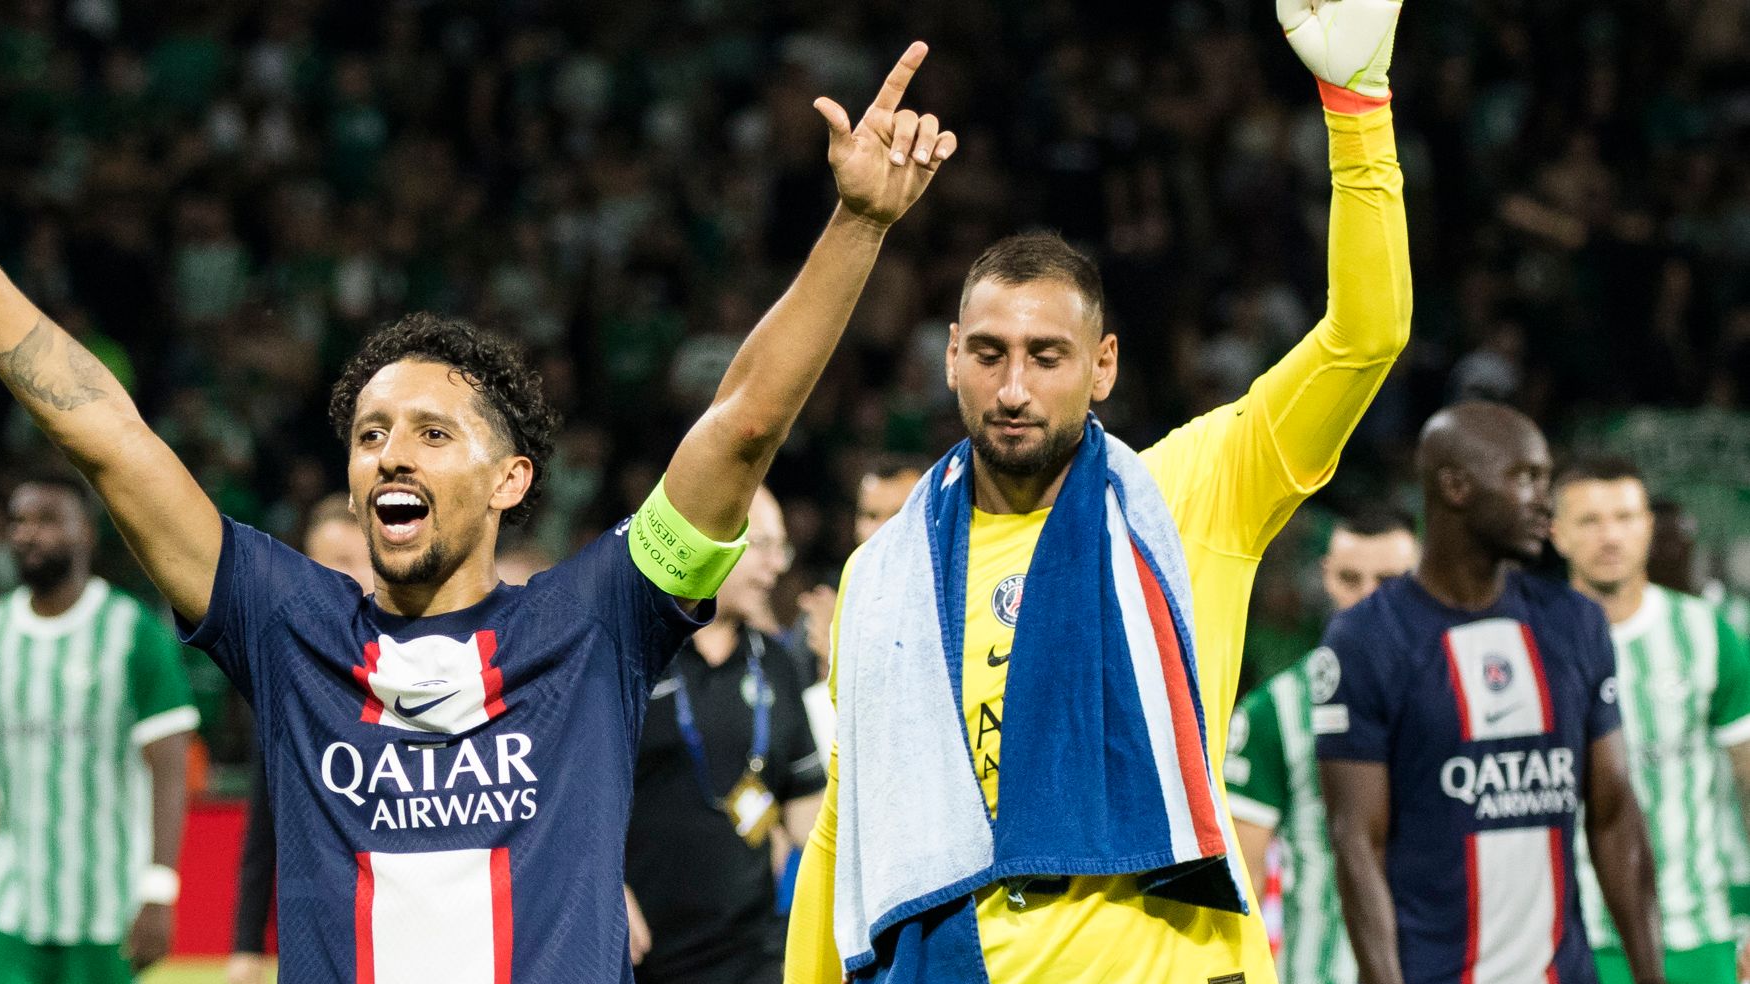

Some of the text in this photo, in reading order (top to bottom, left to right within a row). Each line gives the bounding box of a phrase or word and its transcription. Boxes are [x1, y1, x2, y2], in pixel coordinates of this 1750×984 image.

[646, 503, 677, 548] RESPEC
[650, 549, 666, 567] TO
[666, 564, 688, 580] NO
[1000, 577, 1025, 592] PAR
[321, 732, 538, 806] QATAR
[1440, 747, 1577, 805] QATAR
[370, 788, 537, 831] AIRWAYS
